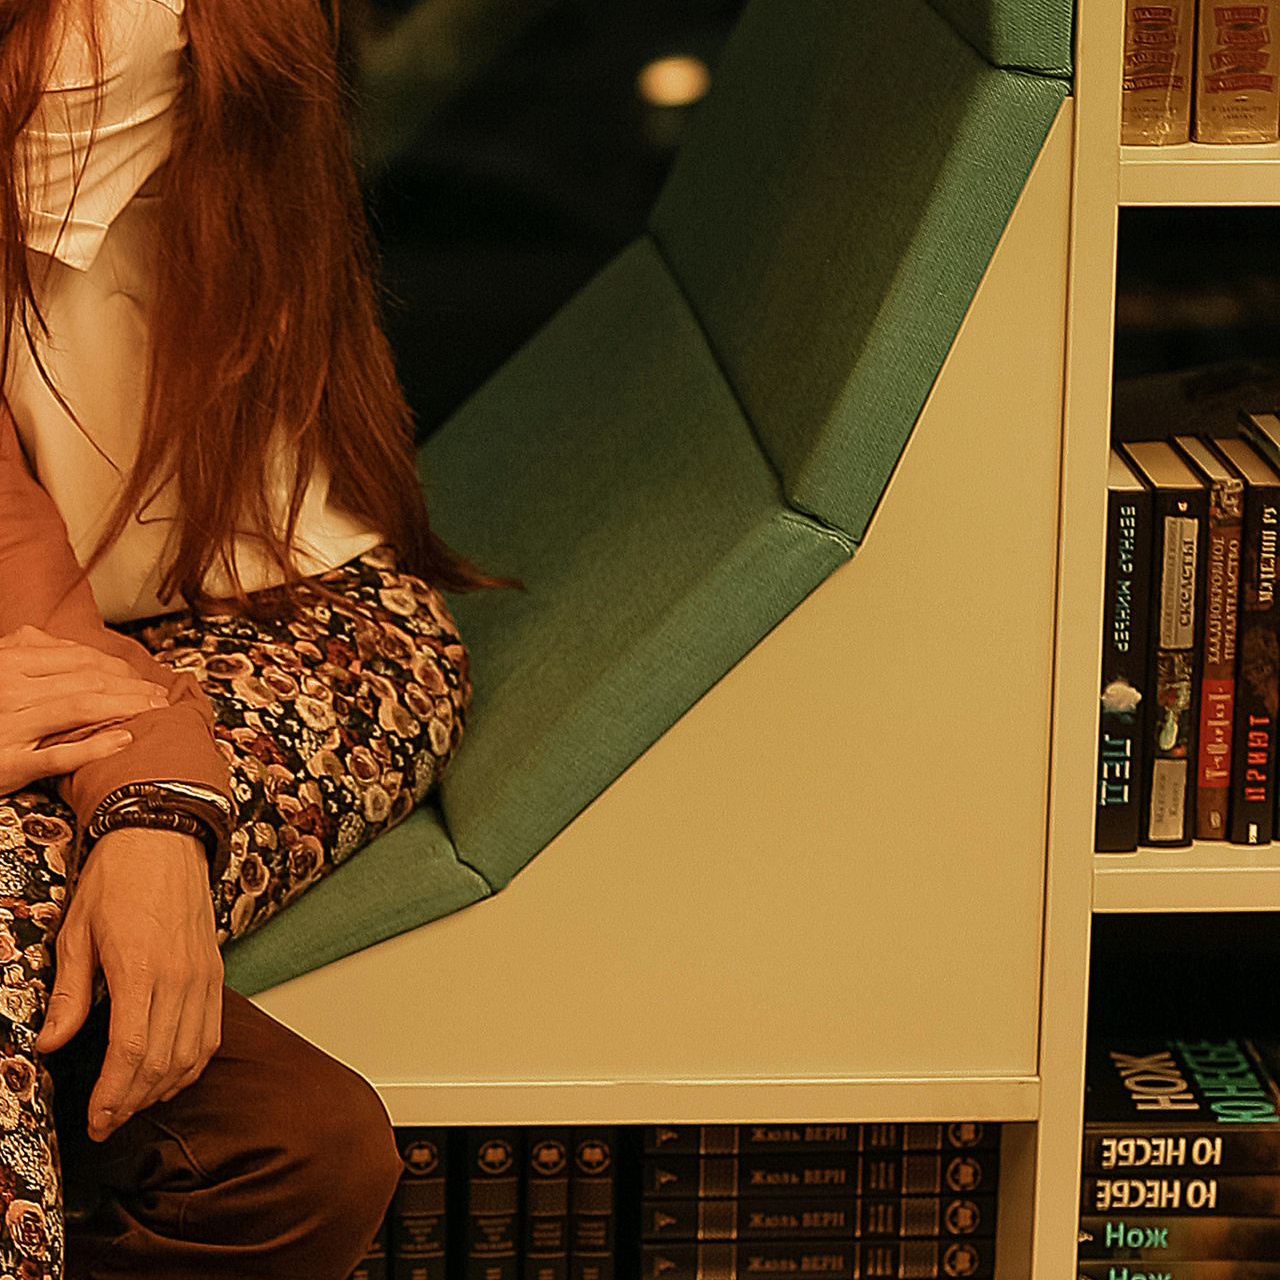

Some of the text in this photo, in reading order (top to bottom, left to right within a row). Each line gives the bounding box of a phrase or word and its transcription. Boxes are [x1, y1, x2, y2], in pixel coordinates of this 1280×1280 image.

[1114, 504, 1136, 653] БЕРНАР МИНЬЕР
[1244, 714, 1270, 802] ПРИЮТ
[1109, 1051, 1200, 1111] НОЖ
[1191, 1136, 1223, 1167] Ю
[1186, 1179, 1218, 1209] Ю
[1104, 1221, 1169, 1250] Нож
